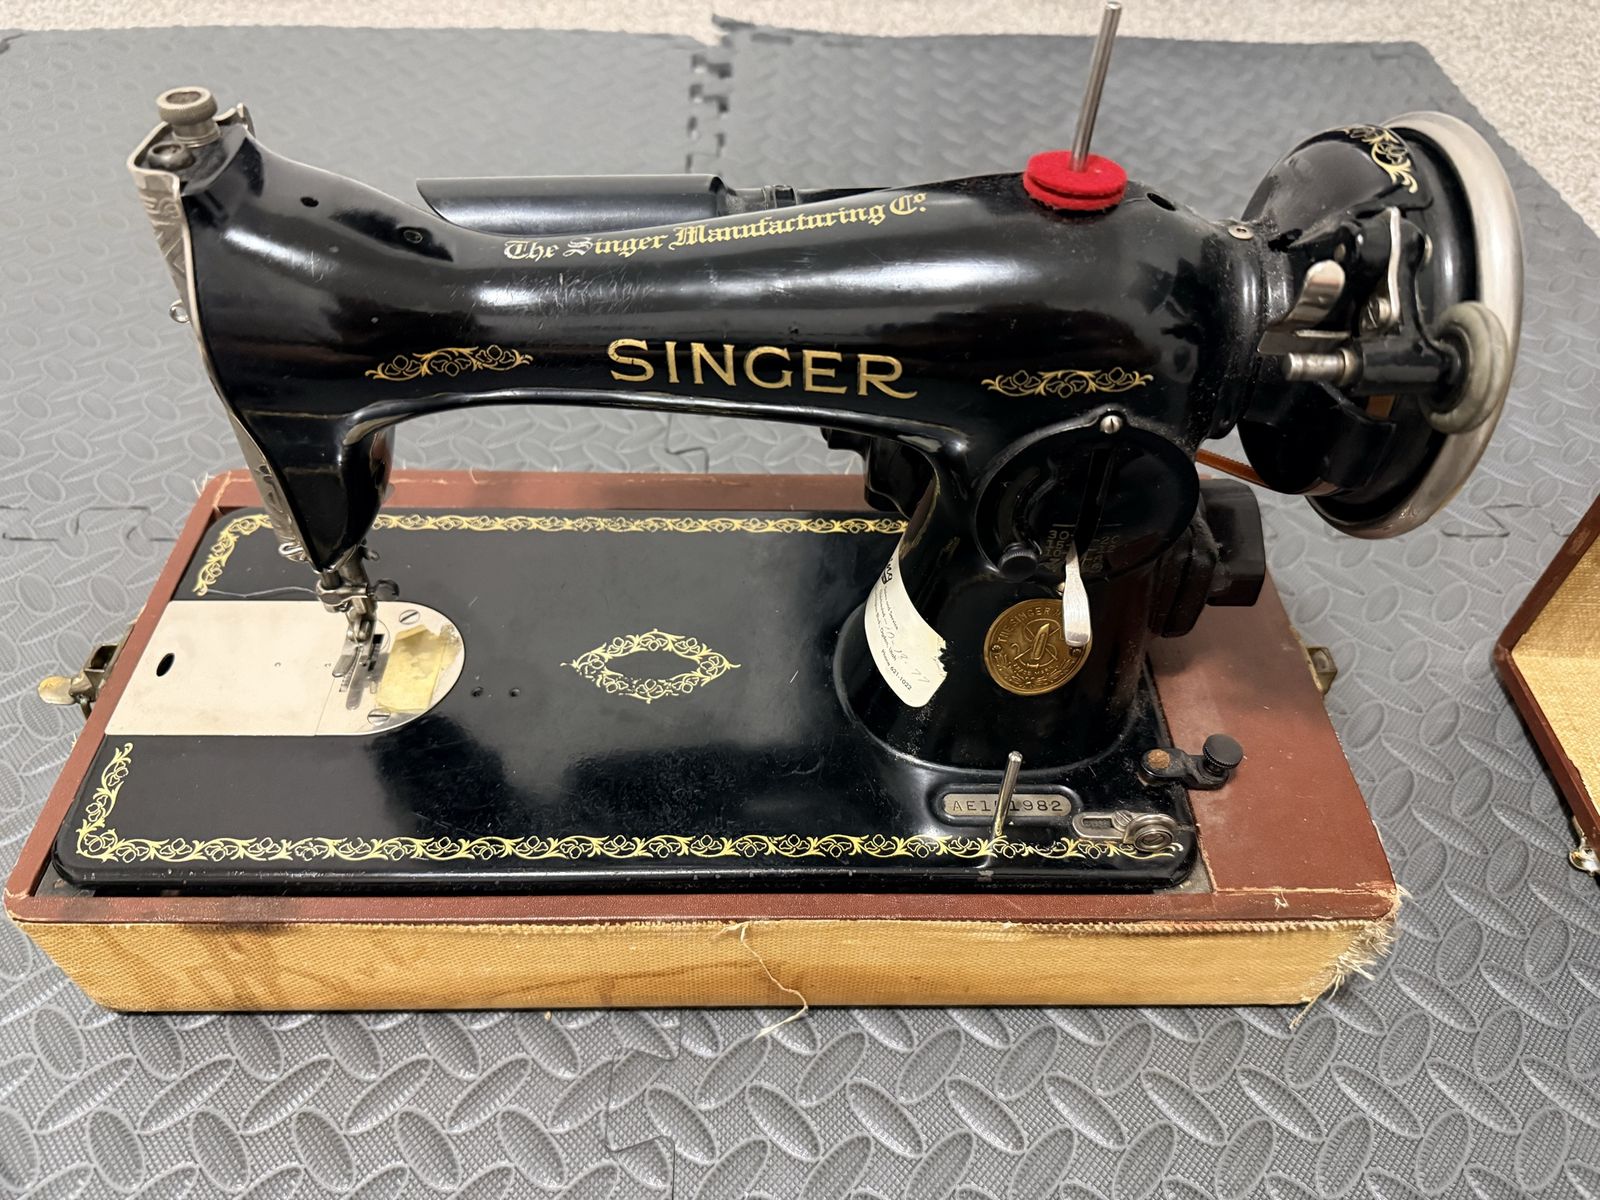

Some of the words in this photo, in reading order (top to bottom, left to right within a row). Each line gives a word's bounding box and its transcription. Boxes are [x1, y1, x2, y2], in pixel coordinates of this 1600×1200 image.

[503, 238, 559, 263] The
[562, 231, 668, 258] Singer
[667, 203, 887, 252] Manufacturing
[607, 338, 918, 400] SINGER
[1010, 606, 1051, 627] SINGER
[952, 799, 1063, 812] AE11982
